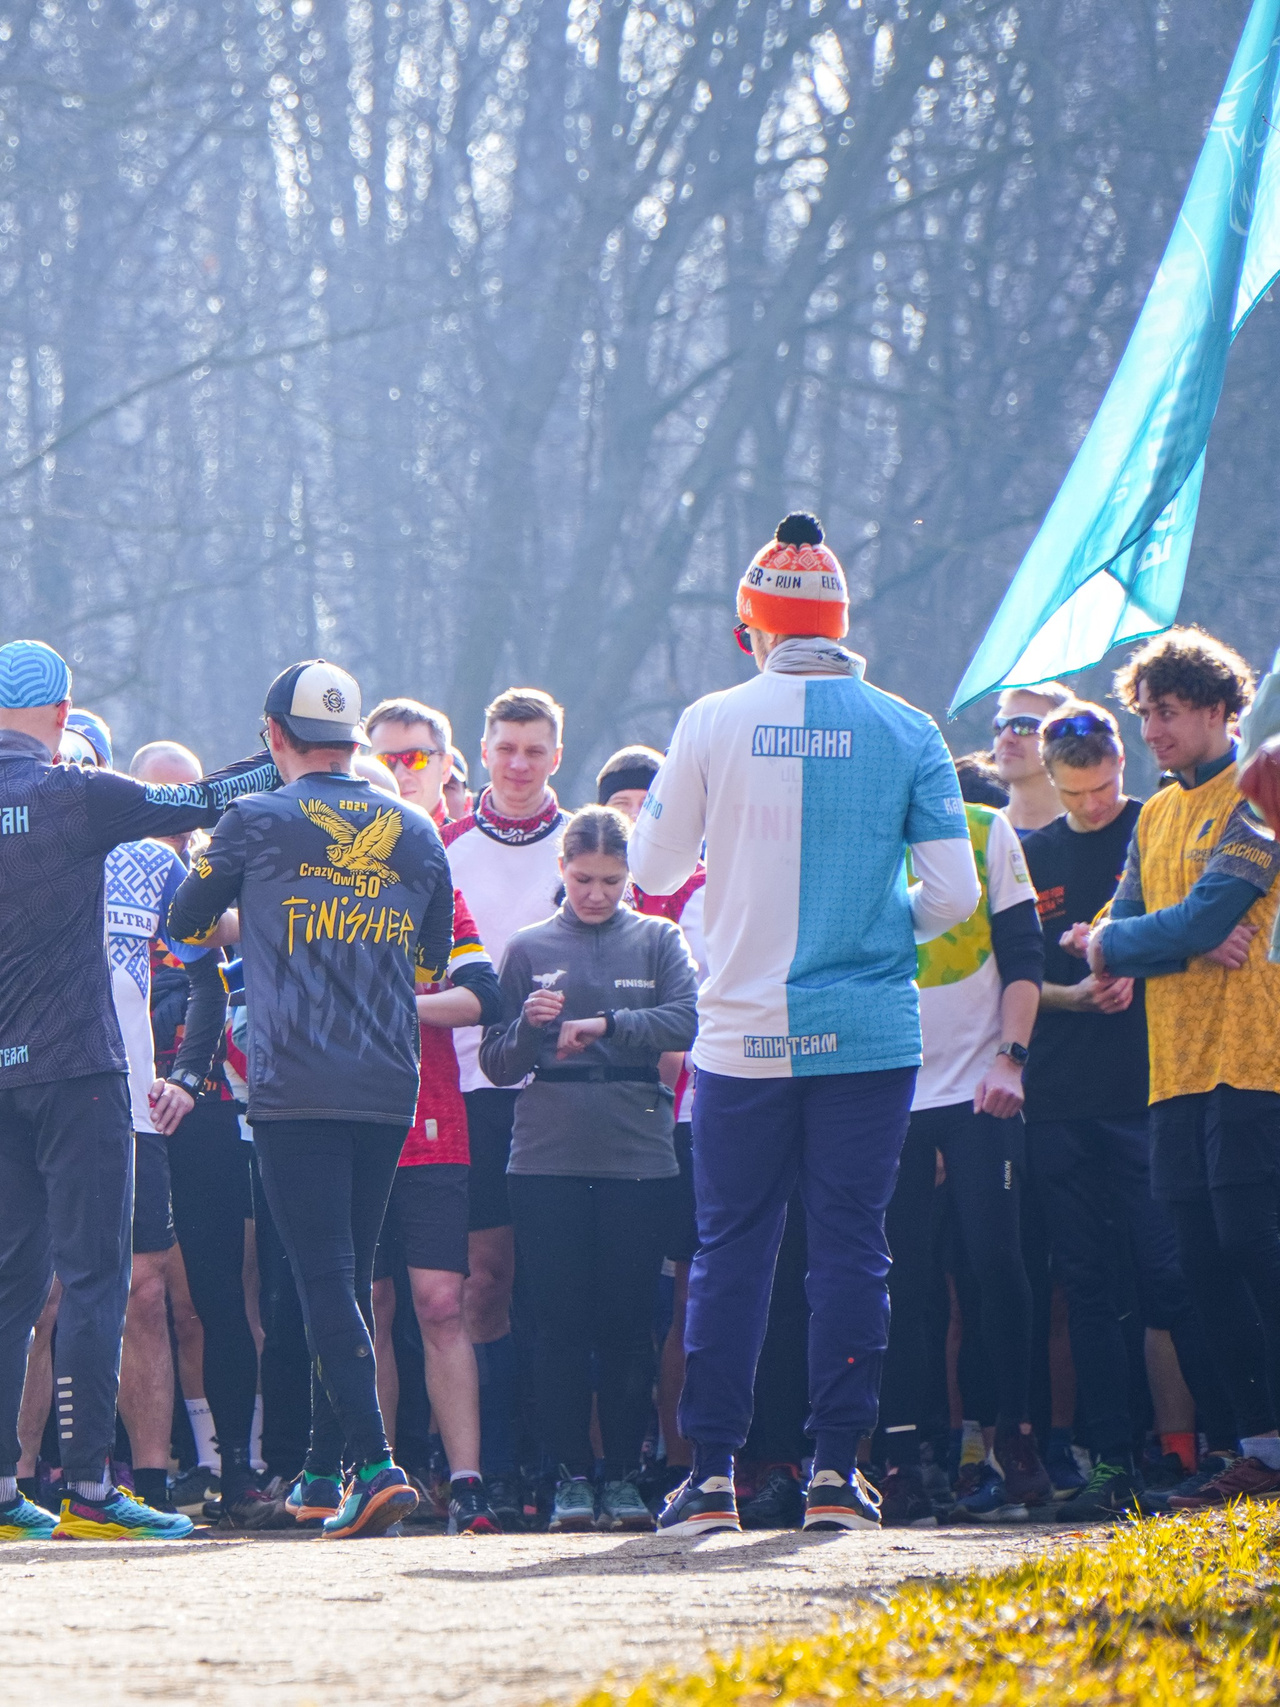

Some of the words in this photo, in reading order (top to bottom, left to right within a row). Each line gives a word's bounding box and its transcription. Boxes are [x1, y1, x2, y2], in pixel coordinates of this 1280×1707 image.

[776, 576, 801, 588] RUN
[822, 576, 842, 590] ELEV
[753, 726, 852, 759] МИШАНЯ
[339, 800, 368, 812] 2024
[299, 863, 334, 880] Crazy
[332, 871, 354, 886] Owl
[354, 874, 381, 898] 50
[614, 979, 656, 989] FINISHE
[744, 1036, 784, 1057] КАПИ
[787, 1033, 837, 1055] TEAM
